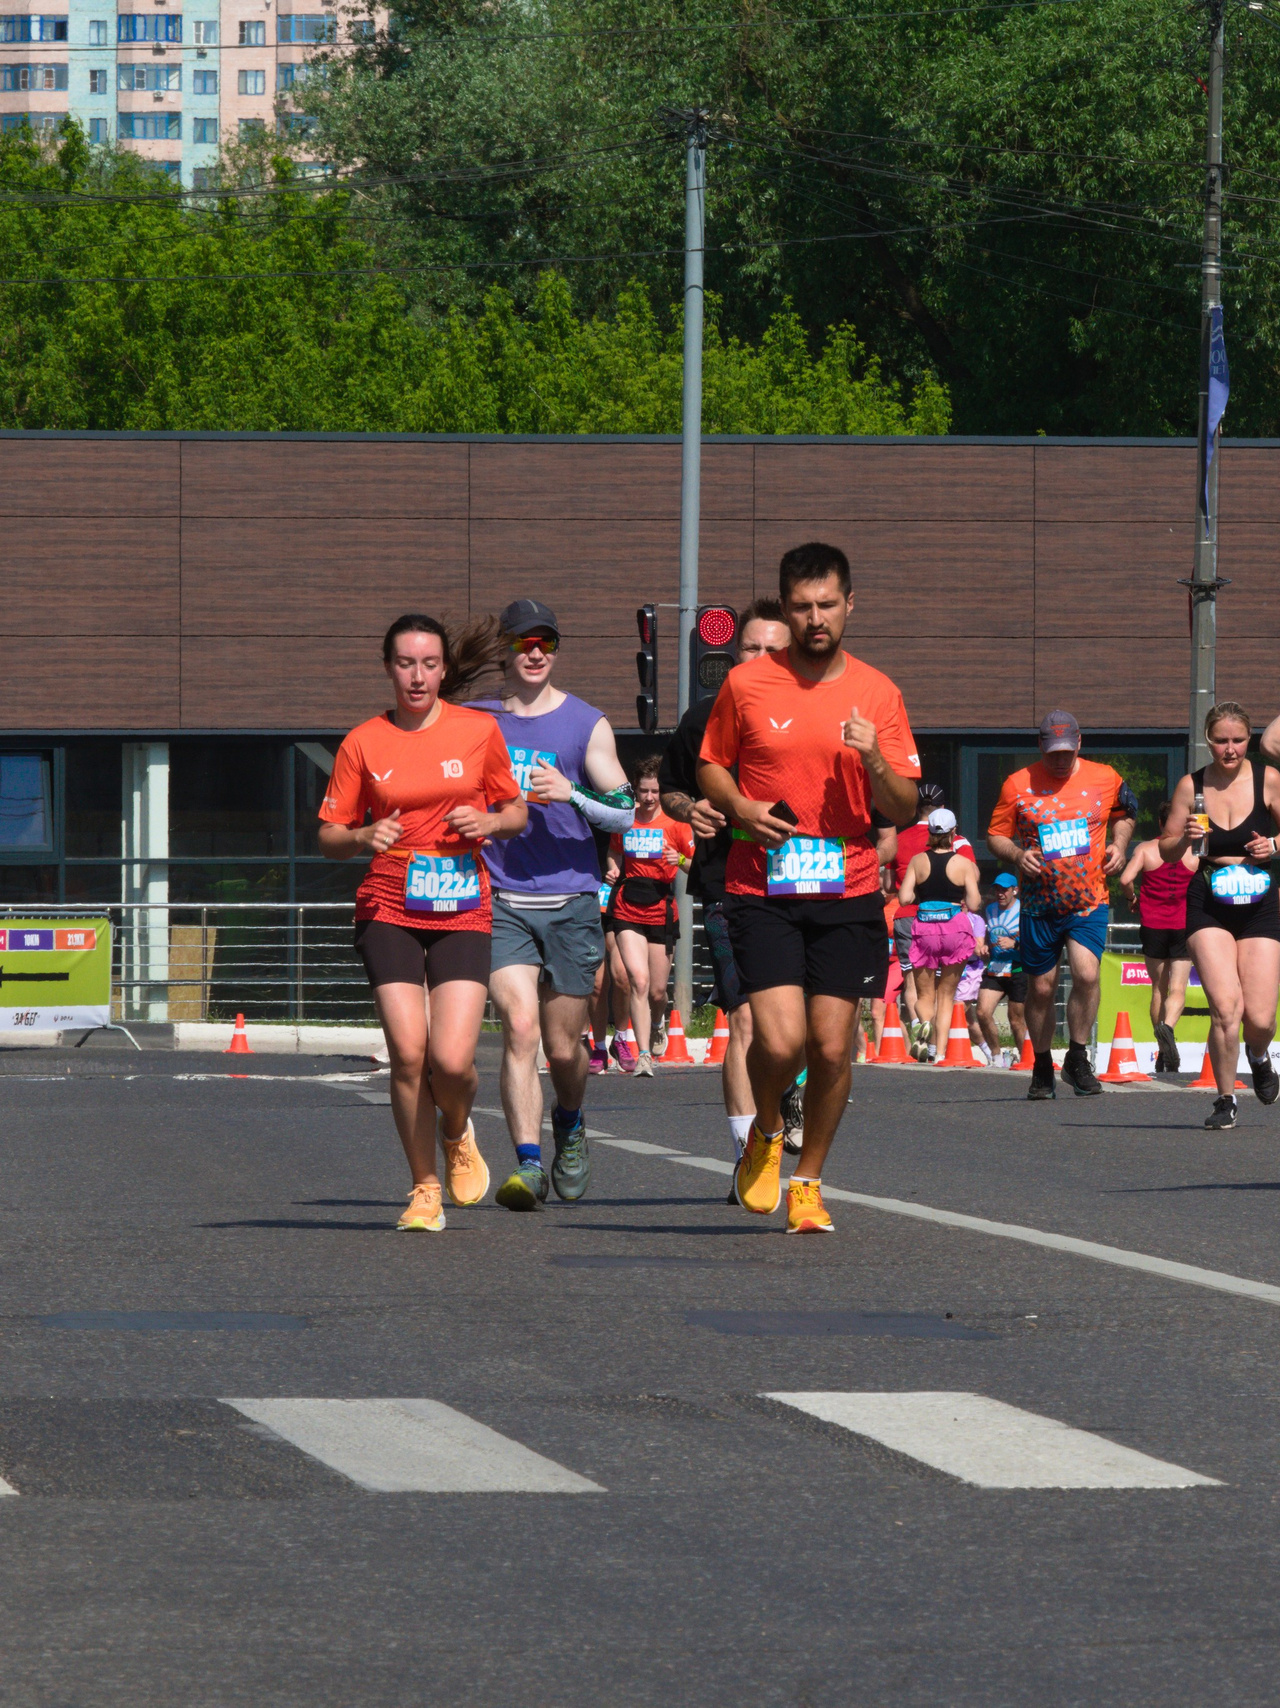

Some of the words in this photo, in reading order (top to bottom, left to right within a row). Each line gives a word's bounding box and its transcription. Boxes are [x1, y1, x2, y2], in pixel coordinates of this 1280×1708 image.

[440, 759, 464, 779] 10
[624, 836, 660, 852] 50256
[1043, 828, 1088, 852] 50078
[440, 858, 454, 871] 10
[772, 851, 840, 881] 50223
[410, 869, 477, 899] 50222
[795, 881, 821, 894] 10KM
[1216, 874, 1267, 896] 50196
[432, 899, 458, 912] 10KM
